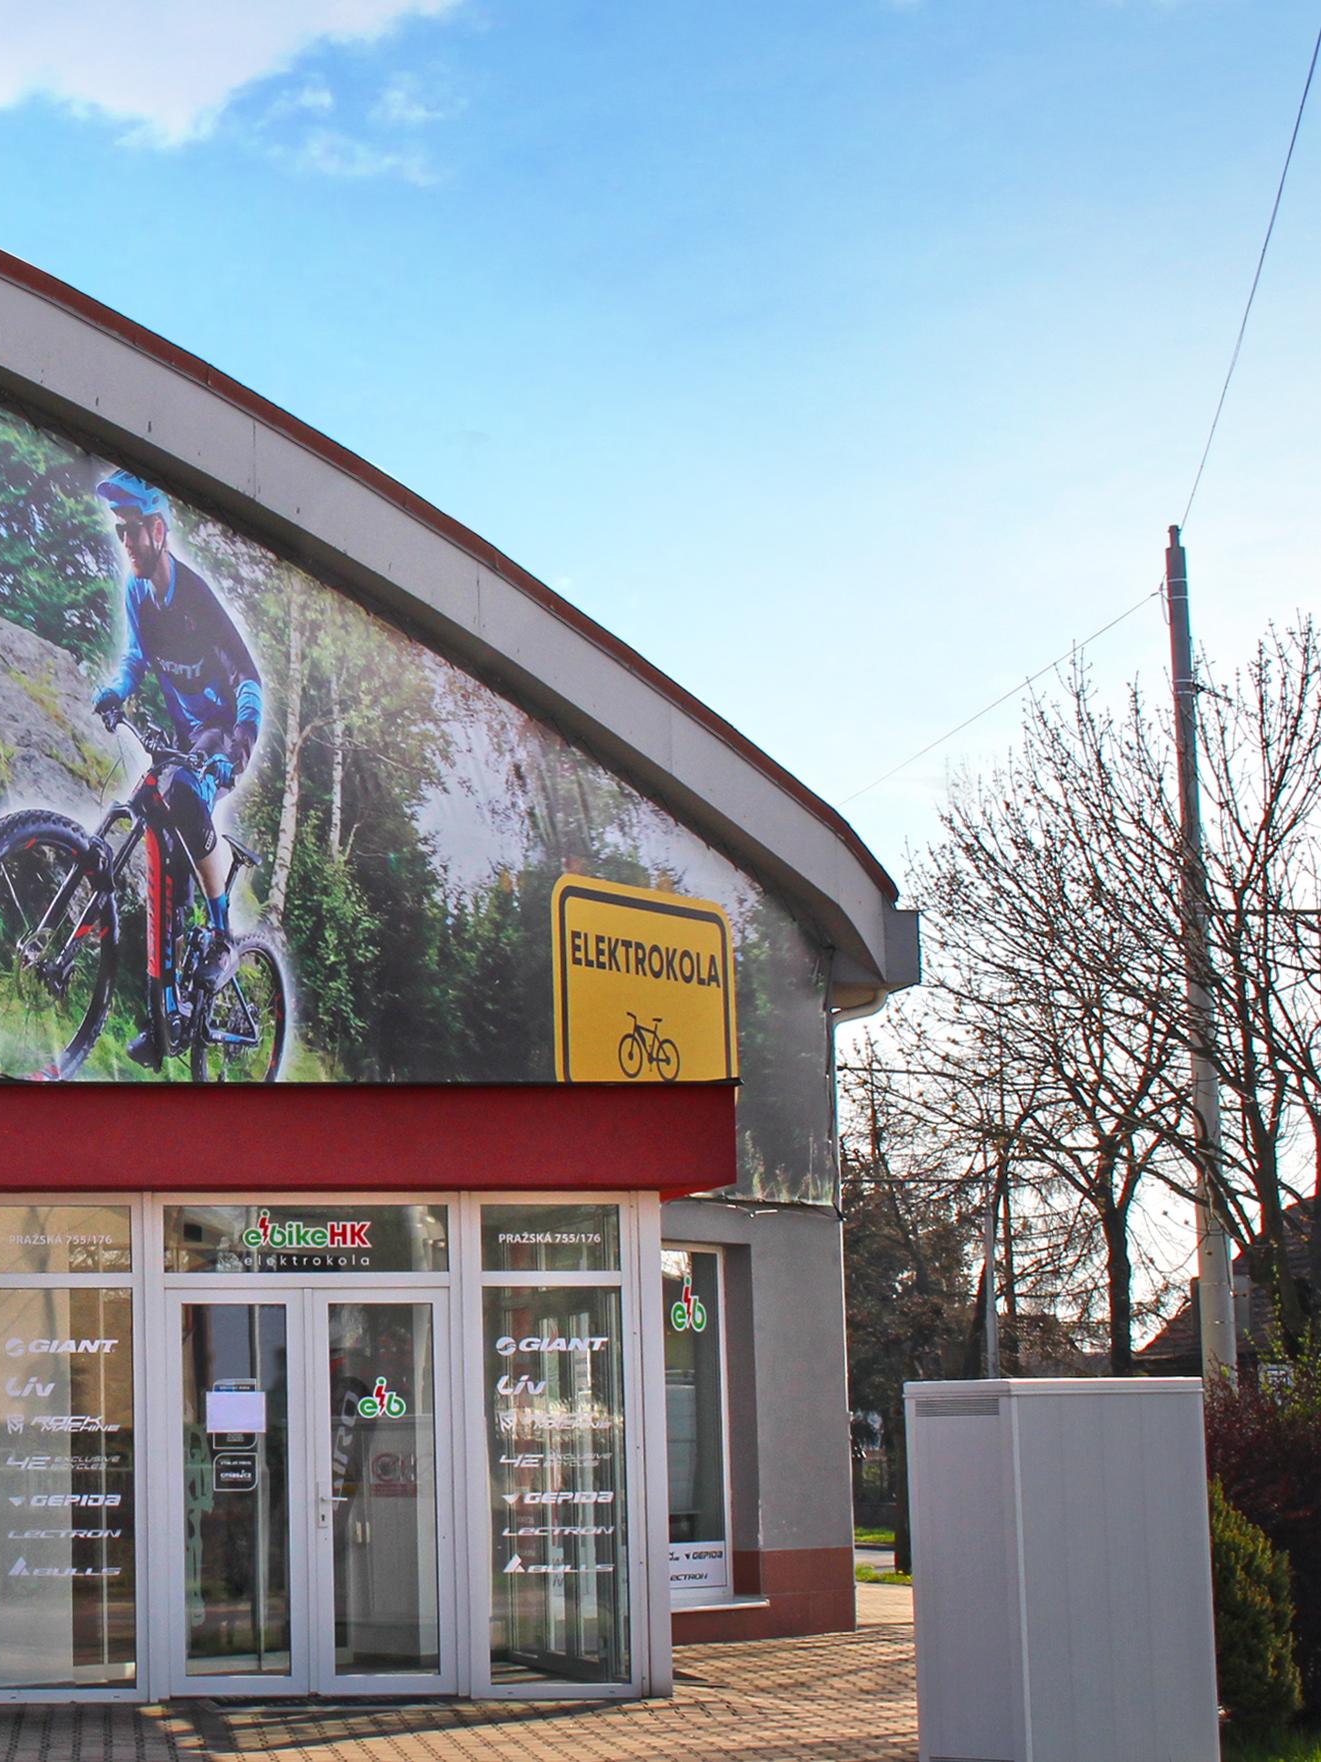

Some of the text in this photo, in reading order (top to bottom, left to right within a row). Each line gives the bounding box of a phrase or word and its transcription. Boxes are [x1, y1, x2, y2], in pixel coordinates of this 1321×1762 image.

[570, 930, 721, 988] ELEKTROKOLA
[66, 1235, 112, 1245] 755/176
[499, 1231, 601, 1243] PRAŽSKÁ 755/176
[244, 1254, 370, 1266] elektrokola
[28, 1339, 119, 1353] GIANT
[519, 1337, 608, 1351] GIANT
[6, 1377, 55, 1397] Liv
[497, 1375, 547, 1395] Liv
[41, 1424, 121, 1432] MACHINE
[33, 1567, 122, 1576] BULLS
[527, 1564, 615, 1573] BULLS
